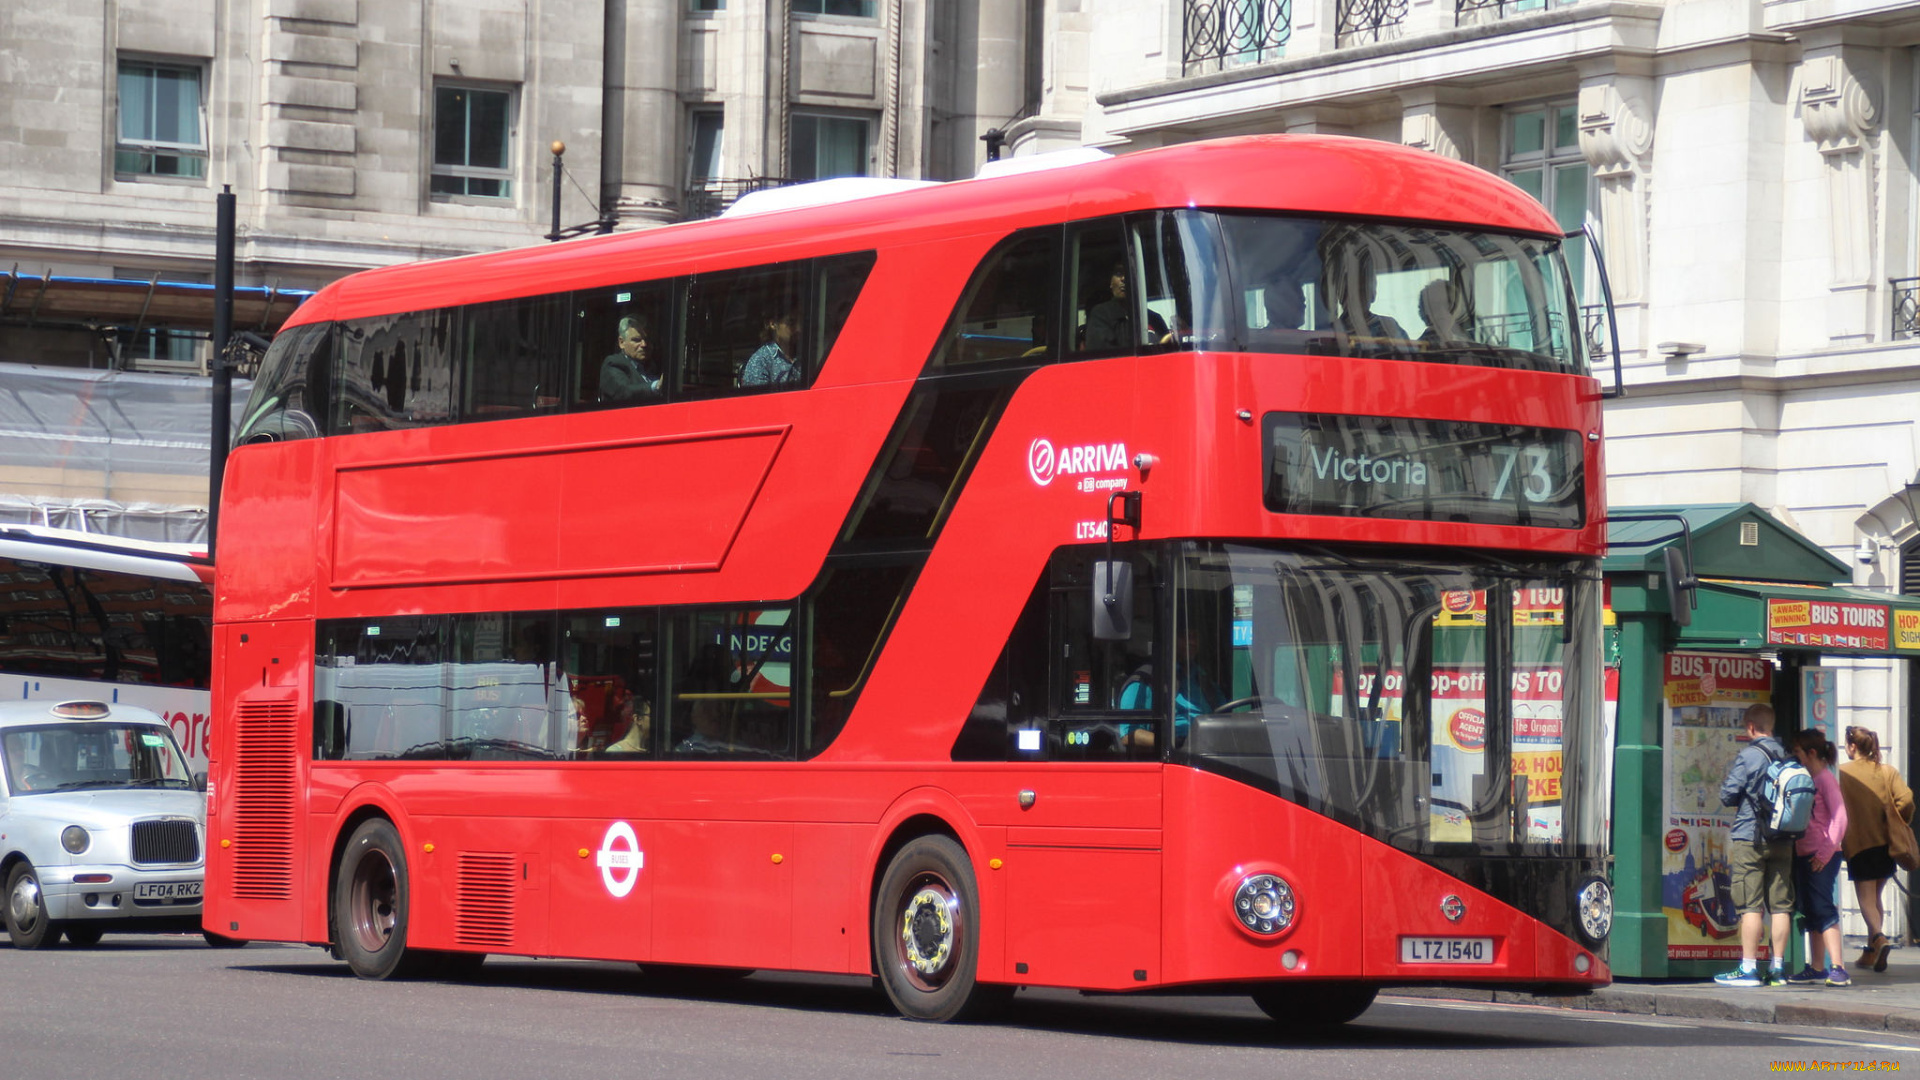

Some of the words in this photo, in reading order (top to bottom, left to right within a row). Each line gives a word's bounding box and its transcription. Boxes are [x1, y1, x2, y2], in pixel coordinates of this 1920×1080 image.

[1057, 443, 1128, 475] ARRIVA
[1310, 446, 1427, 486] Victoria
[1492, 448, 1552, 503] 73
[1077, 481, 1082, 490] a
[1096, 478, 1128, 491] company
[1076, 520, 1109, 539] LT540
[1774, 614, 1807, 624] WINNING
[1776, 604, 1803, 614] AWARD
[1811, 604, 1839, 625] BUS
[1842, 606, 1885, 628] TOURS
[1670, 655, 1704, 677] BUS
[1708, 657, 1765, 680] TOURS
[1459, 722, 1485, 735] AGENT
[1515, 719, 1528, 732] The
[1530, 720, 1558, 736] Original
[139, 885, 173, 897] LF04
[1412, 941, 1443, 959] LTZ
[1447, 941, 1482, 959] 1540
